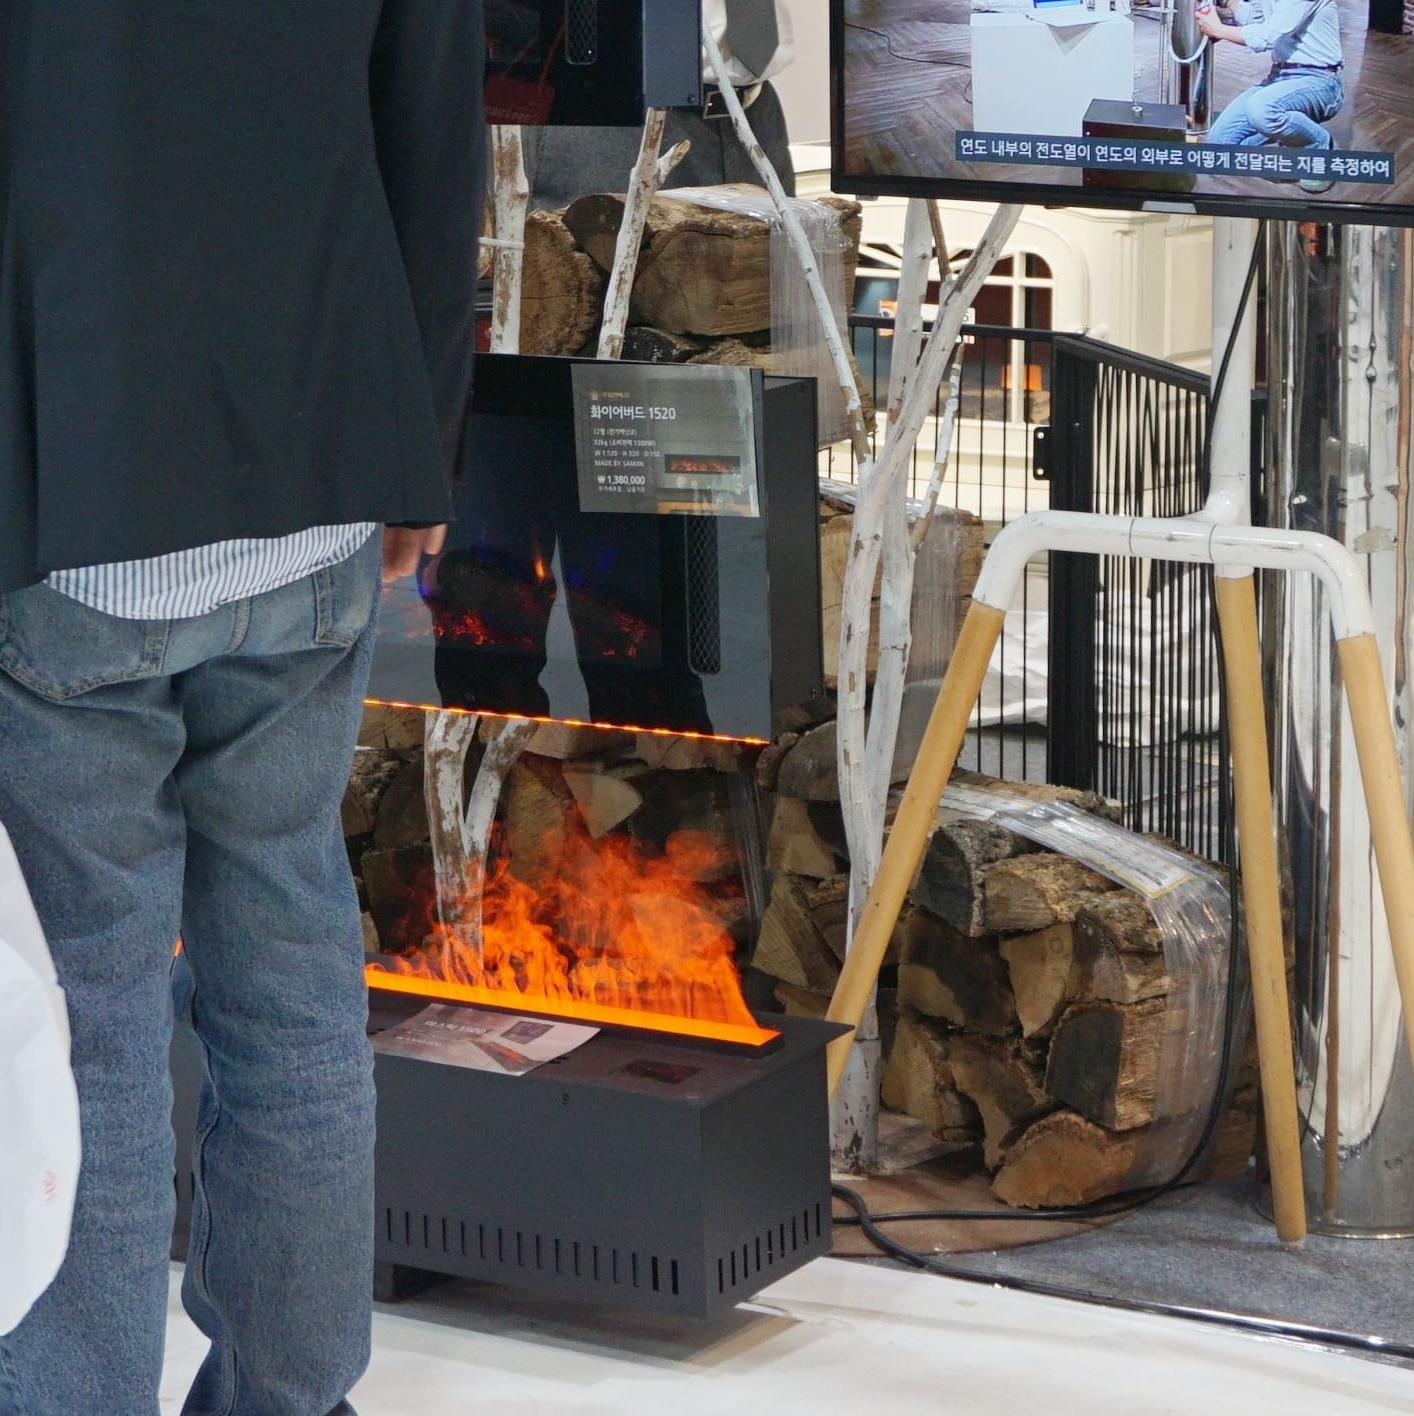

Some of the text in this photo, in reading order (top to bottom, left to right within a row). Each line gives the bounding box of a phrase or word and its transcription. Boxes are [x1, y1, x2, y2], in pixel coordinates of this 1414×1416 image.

[961, 138, 1391, 178] 연도 내부의 전도열이 연도의 외부로 어떻게 전달되는 지를 측정하여
[590, 405, 676, 420] 화이어버드 1520
[607, 475, 646, 485] 1,380,000
